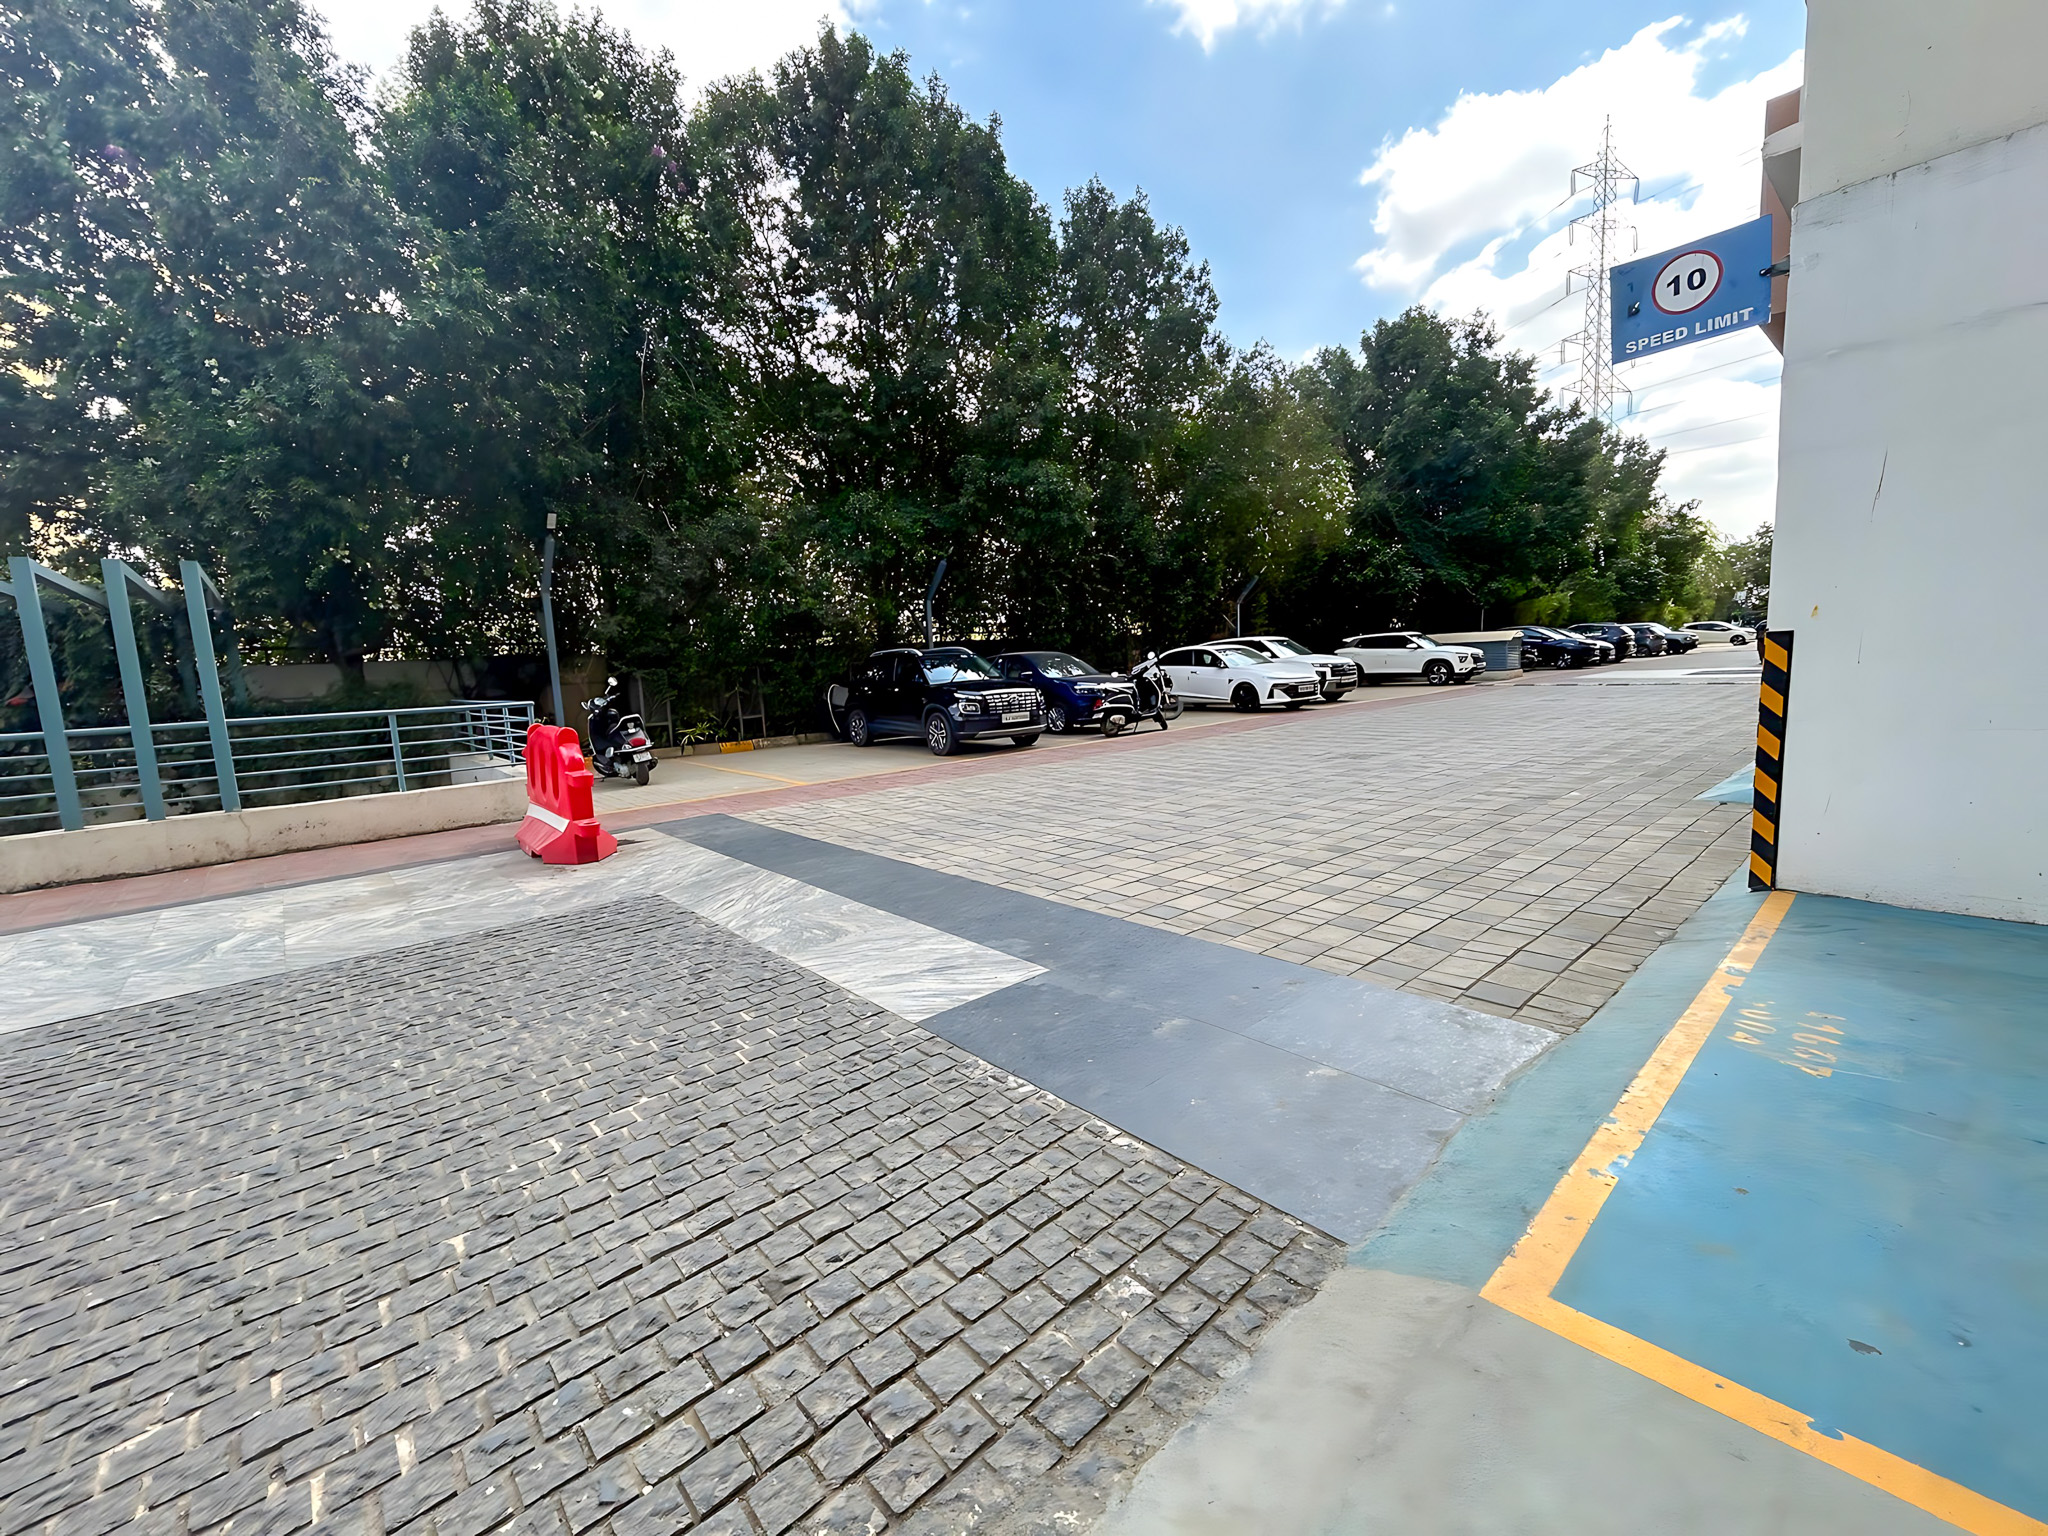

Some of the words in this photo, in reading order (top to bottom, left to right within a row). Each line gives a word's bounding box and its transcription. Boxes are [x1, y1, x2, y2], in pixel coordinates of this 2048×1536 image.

[1666, 267, 1707, 297] 10
[1625, 326, 1688, 354] SPEED
[1694, 307, 1755, 336] LIMIT
